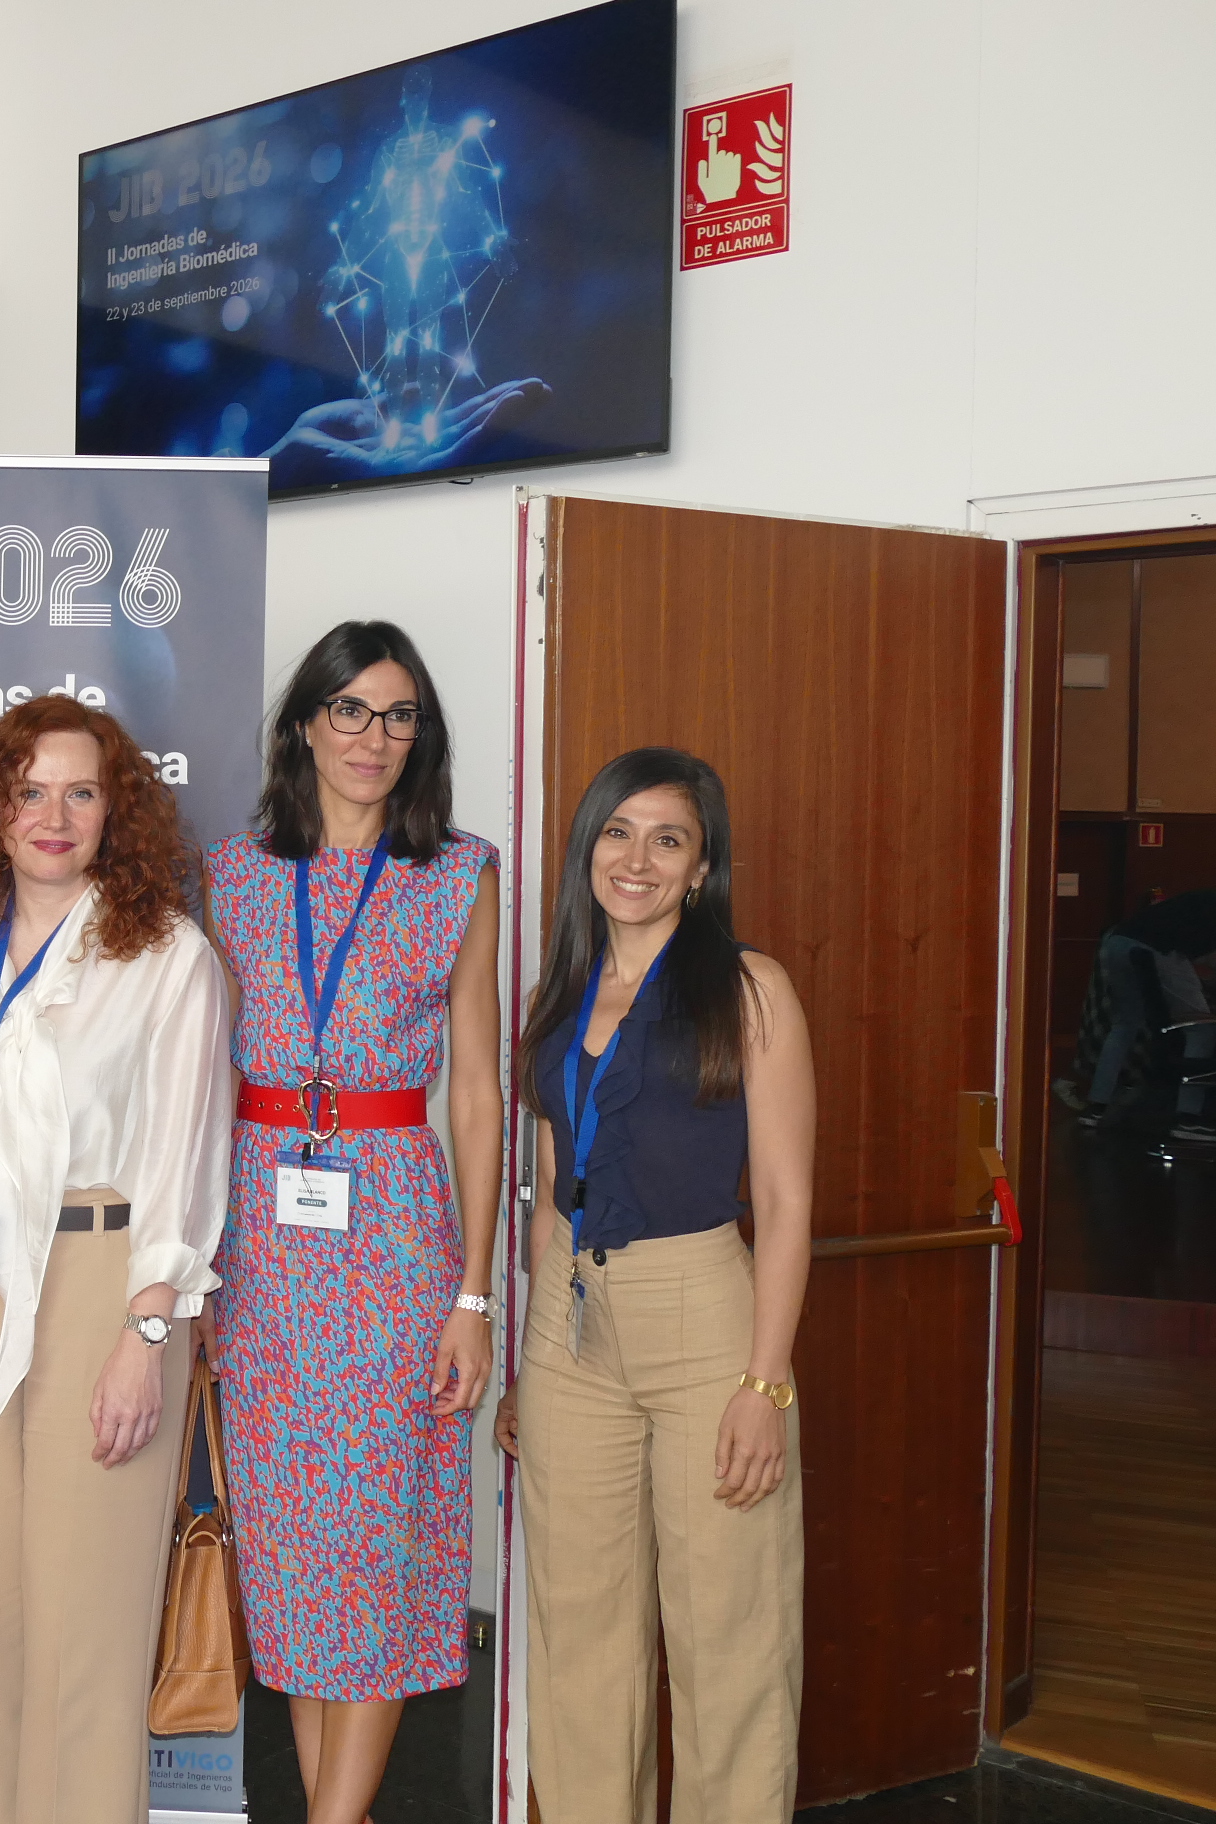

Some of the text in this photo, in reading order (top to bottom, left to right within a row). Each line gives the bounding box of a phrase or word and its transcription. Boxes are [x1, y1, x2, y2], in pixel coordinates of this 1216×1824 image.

[108, 140, 272, 223] JIB 2026
[697, 214, 771, 240] PULSADOR
[107, 227, 207, 266] II Jornadas de
[694, 232, 774, 259] DE ALARMA
[107, 241, 259, 290] Ingeniería Biomédica
[106, 276, 260, 321] 22 y 23 de septiembre 2026
[149, 1770, 232, 1782] ficial de Ingenieros
[200, 1783, 211, 1791] de
[214, 1784, 232, 1792] Vigo
